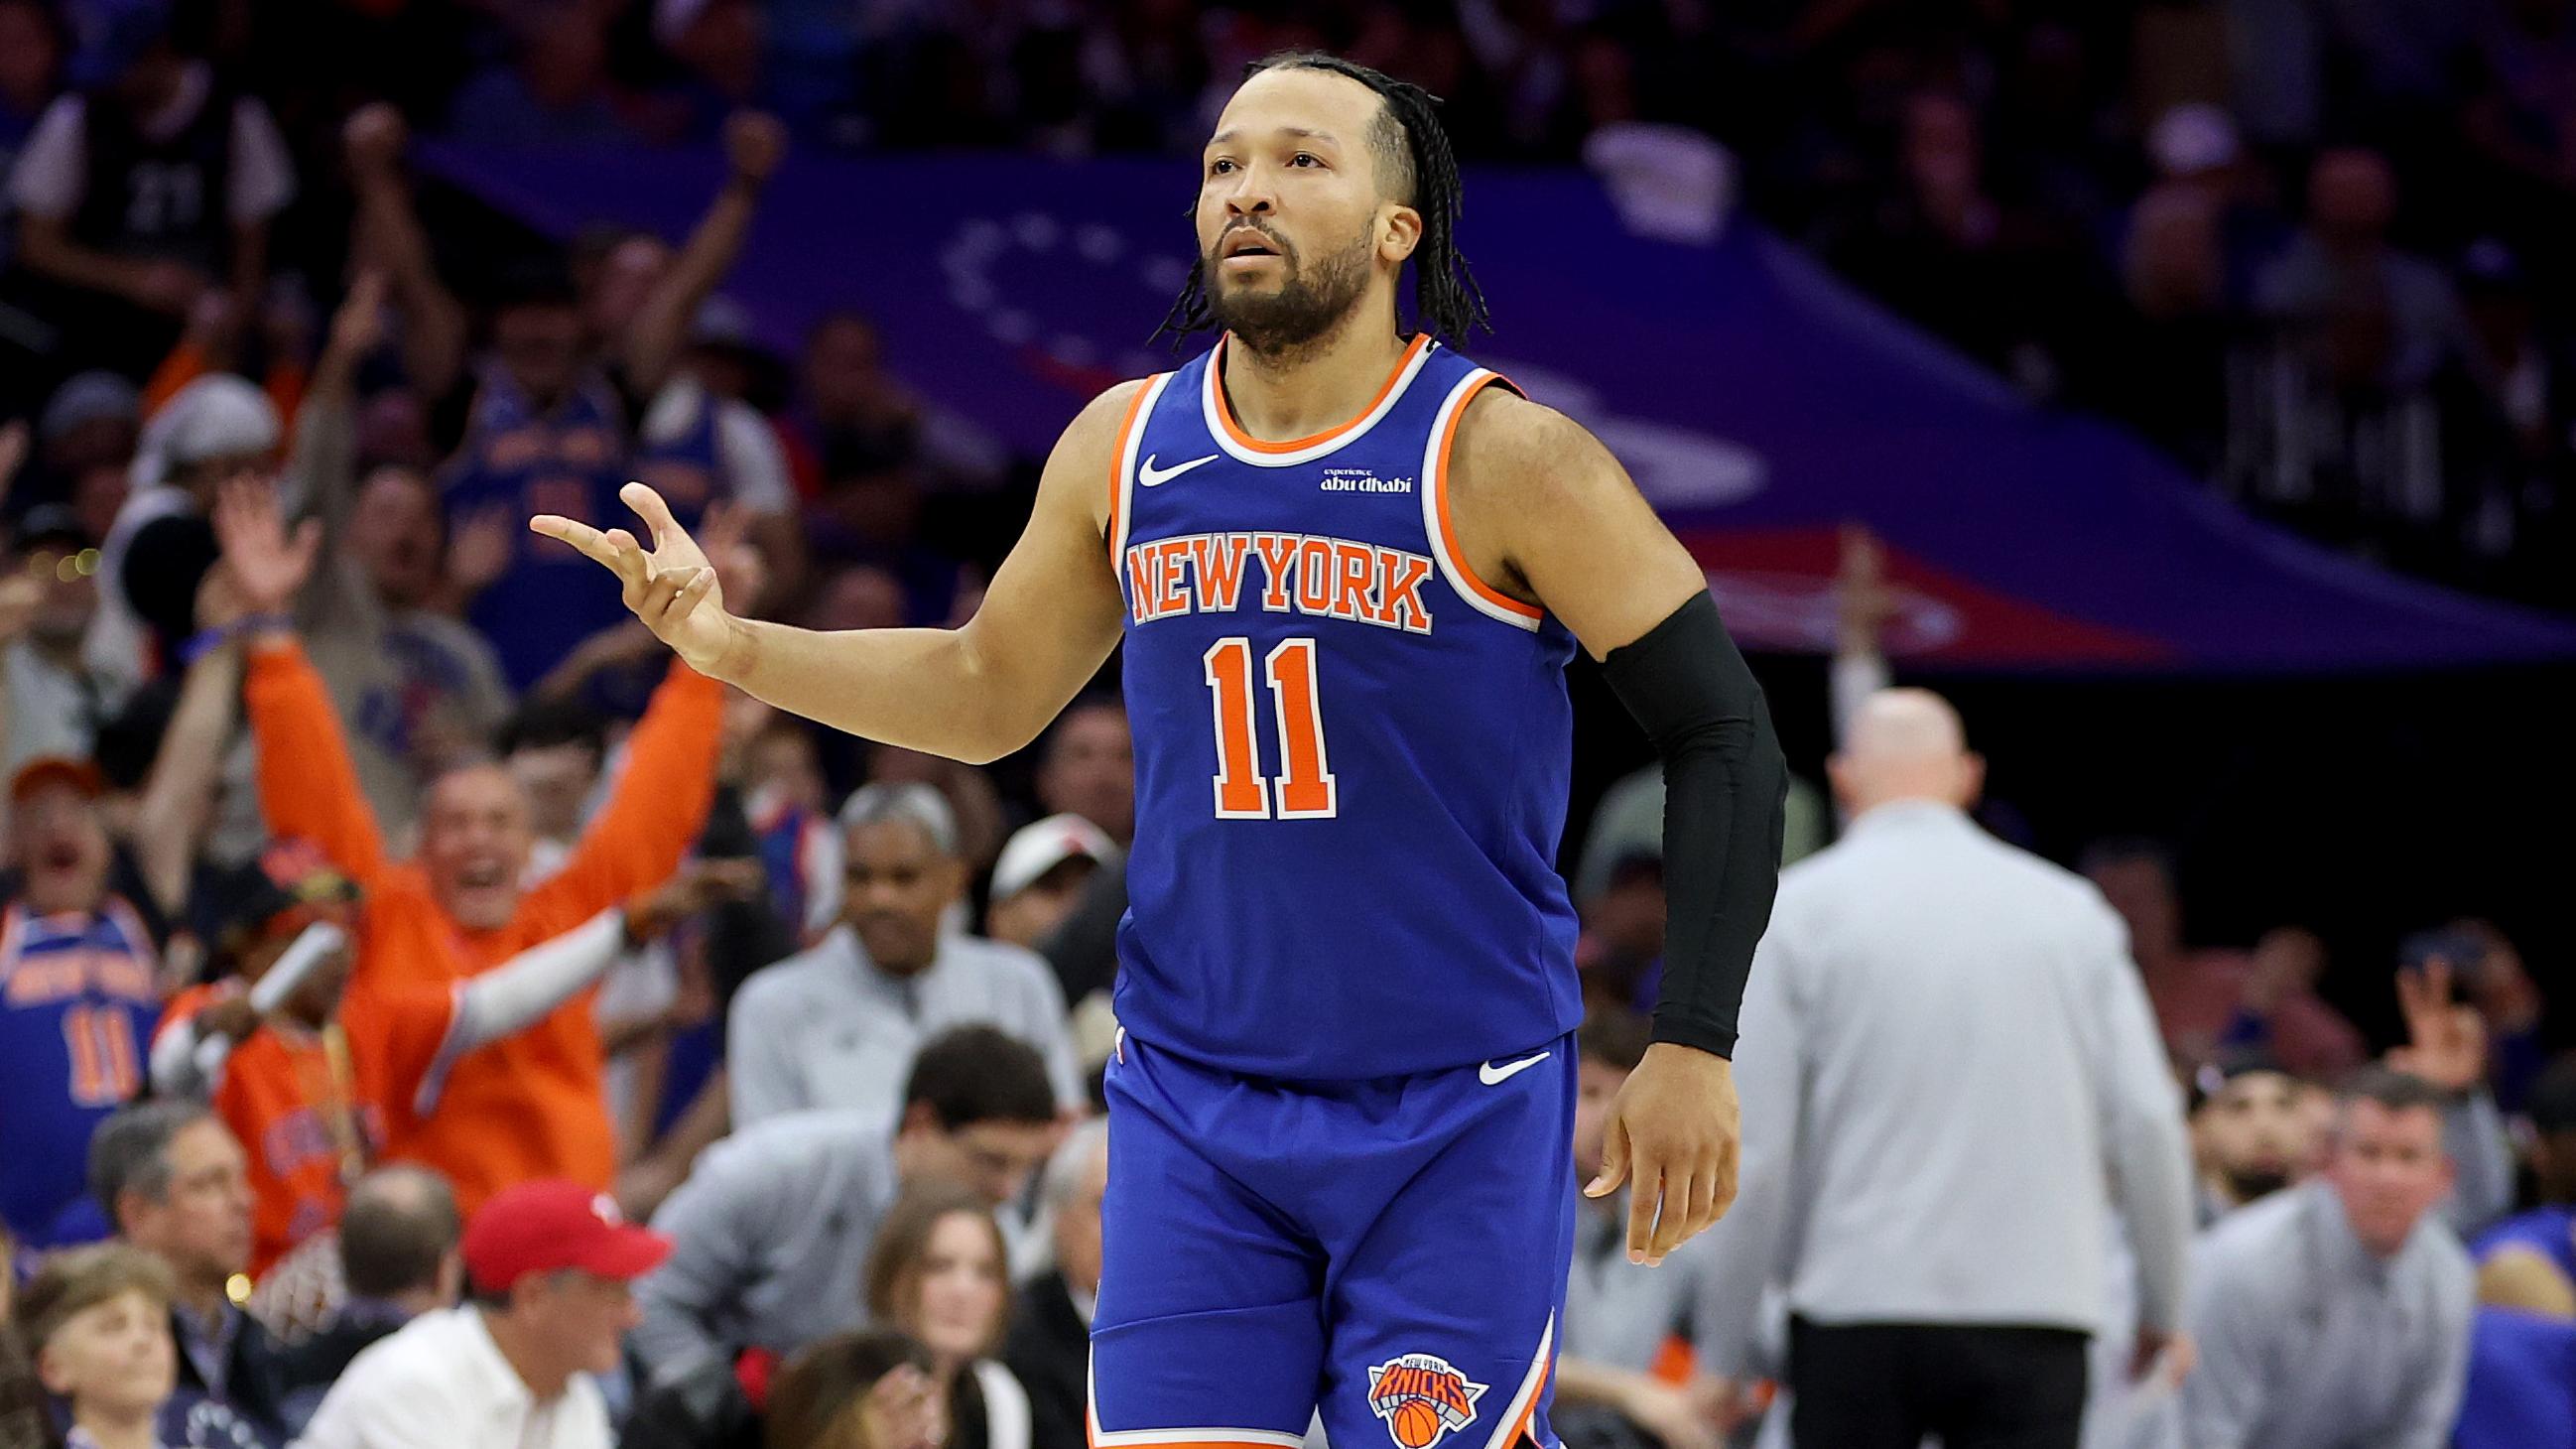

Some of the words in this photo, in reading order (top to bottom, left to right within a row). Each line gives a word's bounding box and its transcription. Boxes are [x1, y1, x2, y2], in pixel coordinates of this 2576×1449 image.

[1320, 476, 1356, 491] abu
[1358, 476, 1413, 493] dhabi
[1126, 532, 1252, 626] NEW
[1252, 531, 1433, 635] YORK
[1203, 637, 1337, 820] 11
[62, 1004, 141, 1109] 11
[1371, 1364, 1472, 1419] KNICKS
[1402, 1358, 1422, 1369] NEW
[1423, 1359, 1445, 1375] YORK
